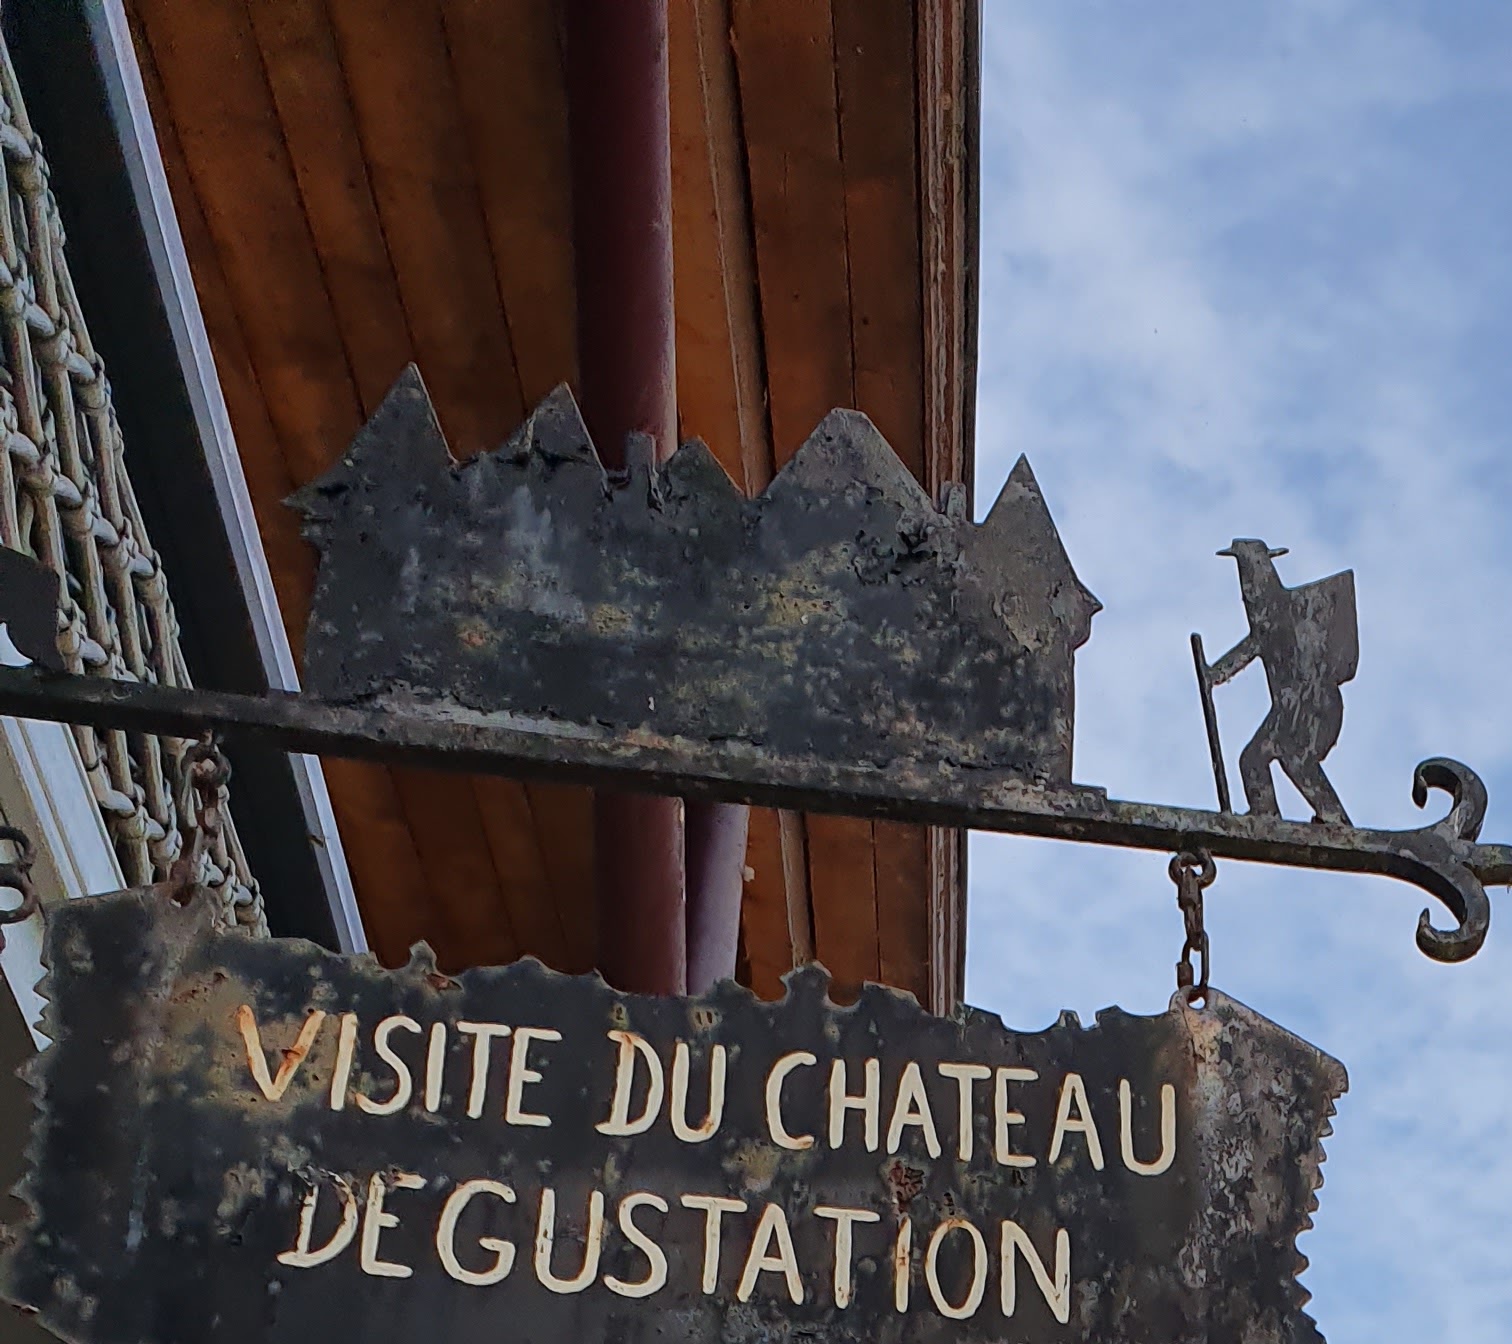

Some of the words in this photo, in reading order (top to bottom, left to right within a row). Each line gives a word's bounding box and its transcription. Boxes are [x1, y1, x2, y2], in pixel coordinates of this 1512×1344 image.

[236, 1003, 564, 1127] VISITE
[595, 1028, 728, 1144] DU
[764, 1050, 1177, 1177] CHATEAU
[275, 1164, 1071, 1325] DEGUSTATION
